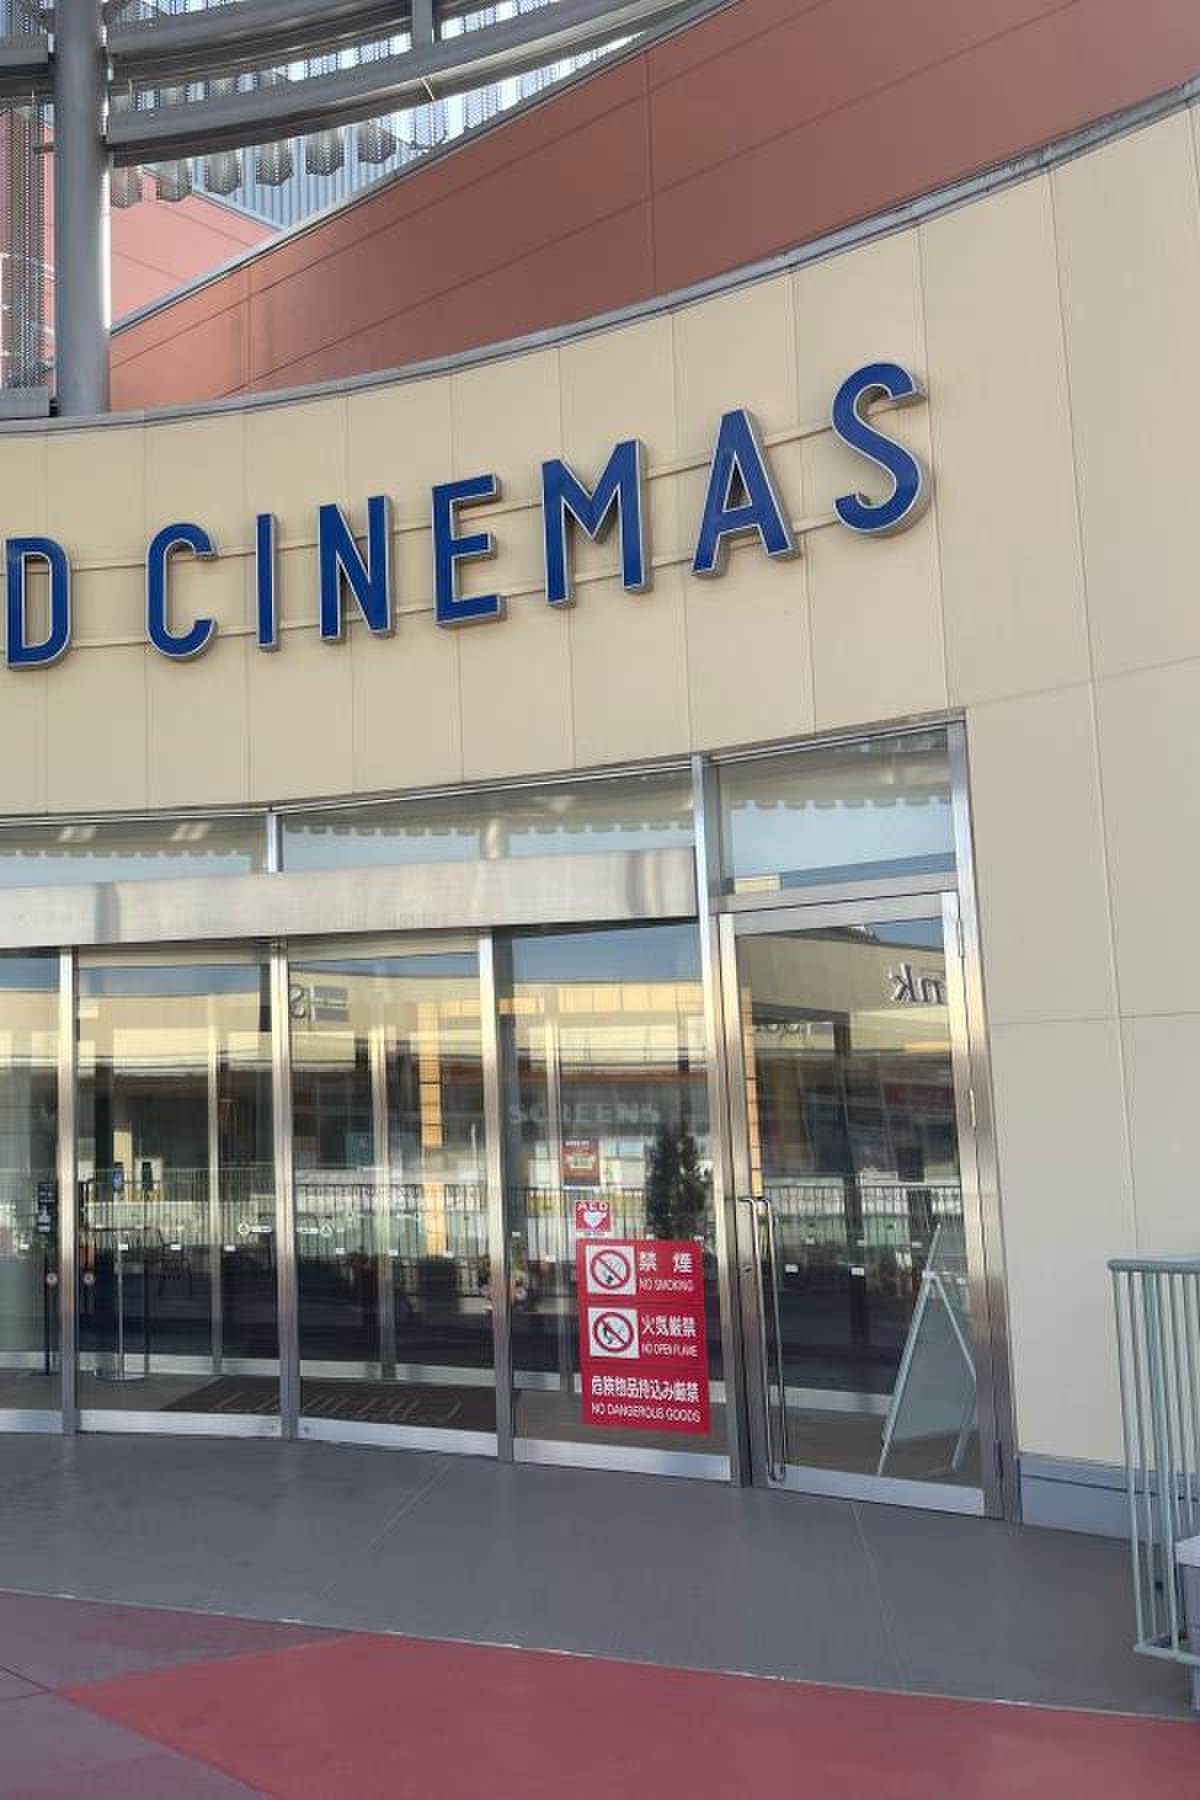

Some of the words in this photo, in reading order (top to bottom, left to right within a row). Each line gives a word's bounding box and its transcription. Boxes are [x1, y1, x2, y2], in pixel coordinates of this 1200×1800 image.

[145, 361, 930, 662] CINEMAS
[577, 1201, 608, 1211] AED
[639, 1279, 652, 1291] NO
[655, 1279, 694, 1292] SMOKING
[641, 1315, 696, 1337] 火気厳禁
[641, 1343, 653, 1354] NO
[655, 1343, 672, 1355] OPEN
[673, 1344, 698, 1357] FLAME
[591, 1402, 605, 1415] NO
[607, 1404, 664, 1419] DANGEROUS
[665, 1408, 700, 1423] GOODS
